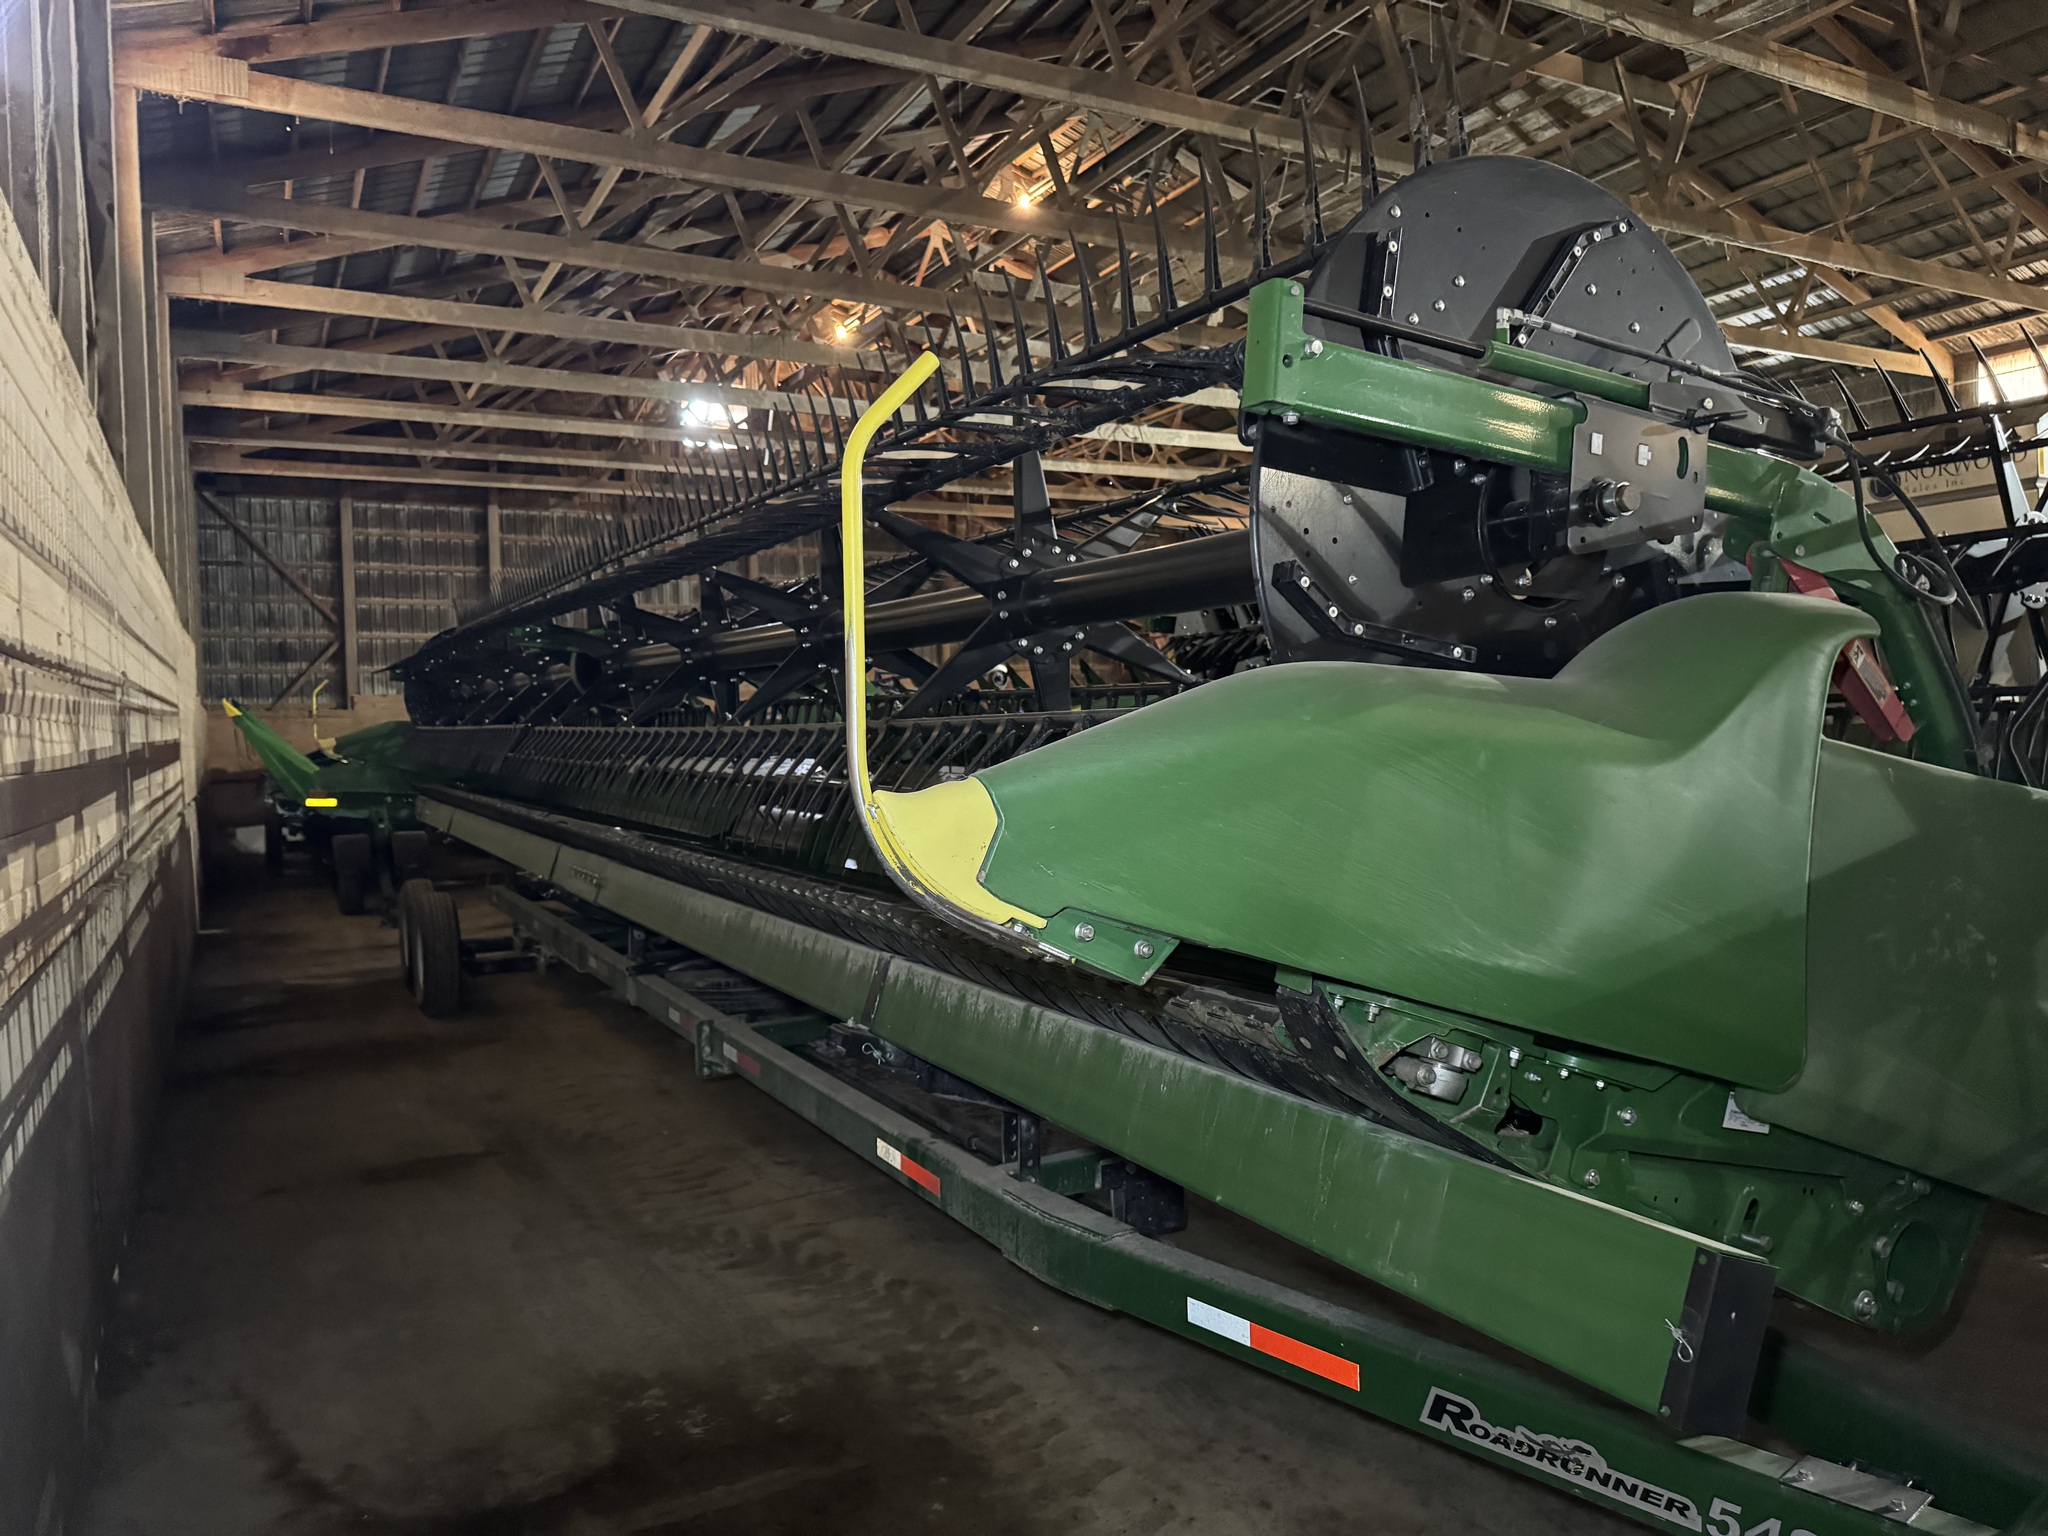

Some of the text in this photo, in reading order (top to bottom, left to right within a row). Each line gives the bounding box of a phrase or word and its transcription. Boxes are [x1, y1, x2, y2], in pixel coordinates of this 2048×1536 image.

[1904, 451, 2027, 482] NORWOD
[1904, 481, 1938, 493] Sales
[1427, 1394, 1692, 1518] ROADRUNNER
